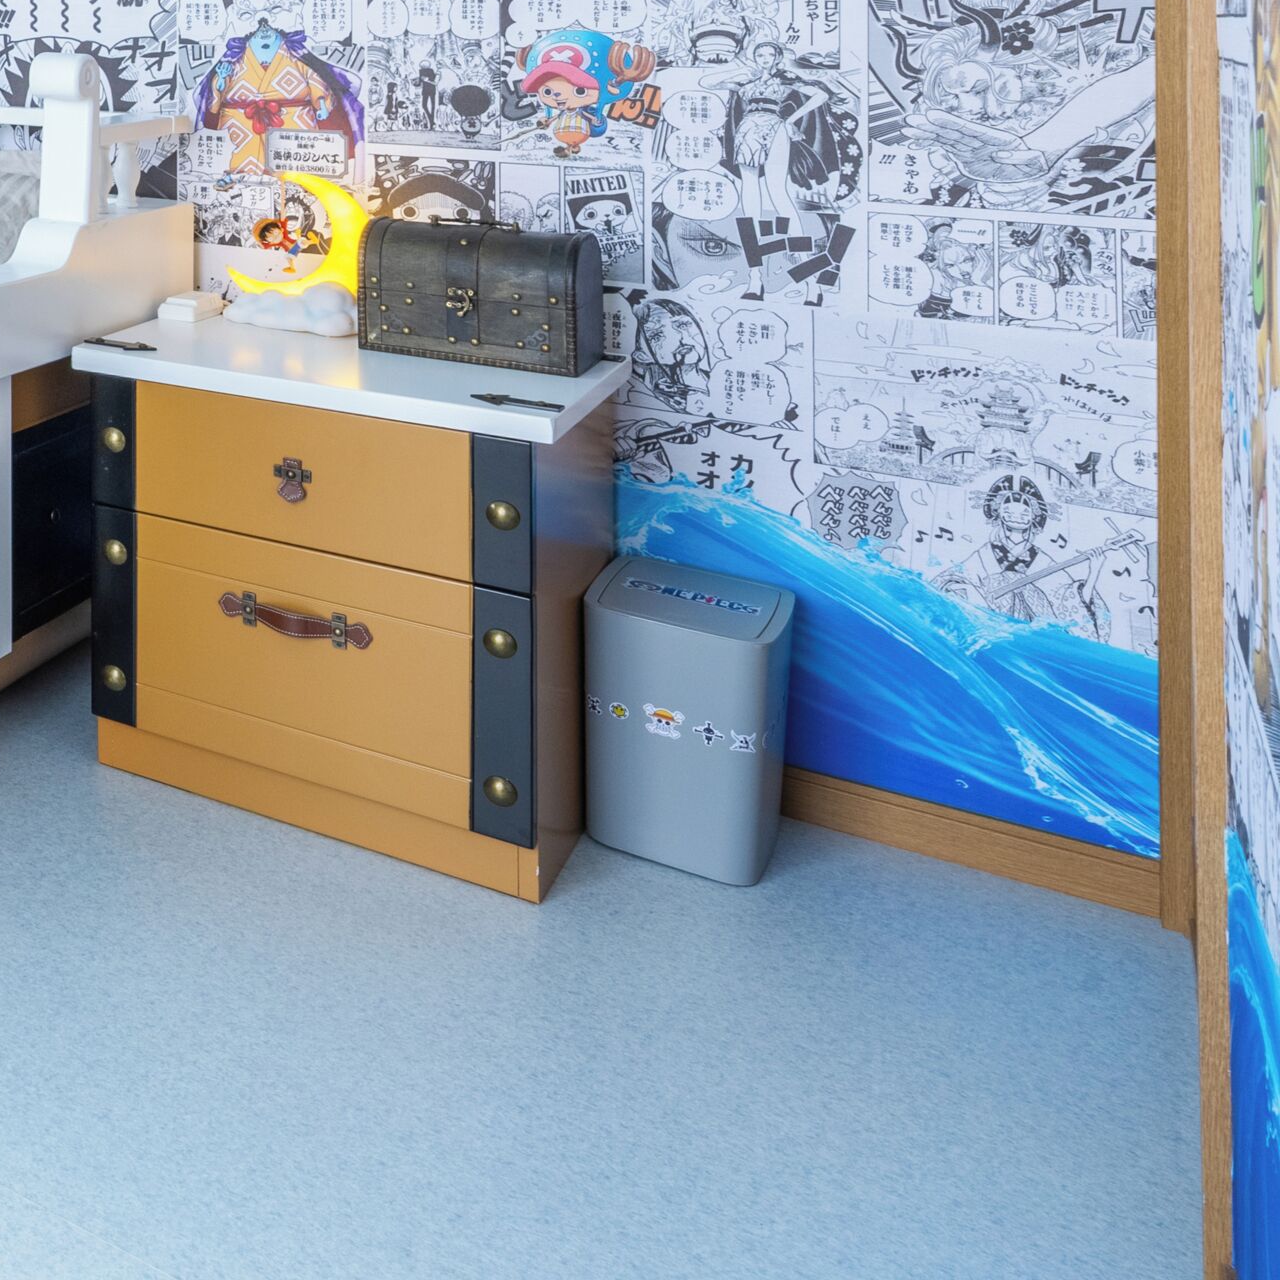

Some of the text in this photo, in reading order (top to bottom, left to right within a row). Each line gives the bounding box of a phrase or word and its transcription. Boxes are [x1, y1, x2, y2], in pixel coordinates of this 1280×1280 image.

[902, 153, 920, 195] きゃあ
[601, 239, 639, 253] HOPPER
